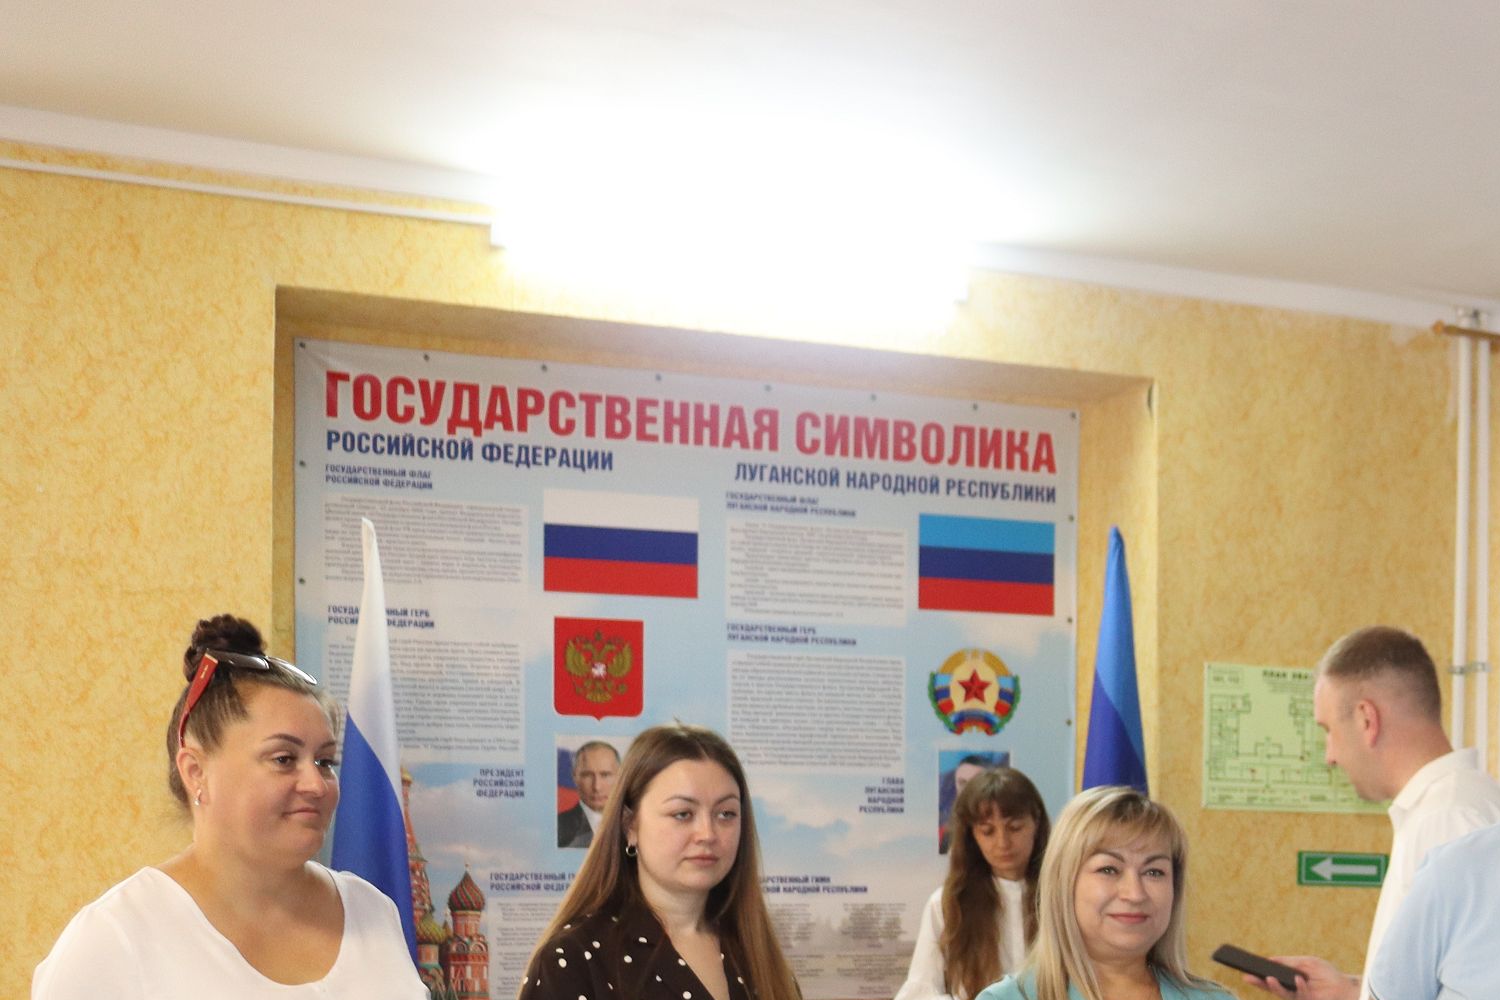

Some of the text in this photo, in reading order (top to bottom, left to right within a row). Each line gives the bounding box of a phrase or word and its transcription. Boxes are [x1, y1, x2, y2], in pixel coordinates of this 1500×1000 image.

[325, 370, 1057, 474] ГОСУДАРСТВЕННАЯ СИМВОЛИКА
[326, 430, 614, 473] РОССИЙСКОЙ ФЕДЕРАЦИИ
[325, 463, 432, 479] ГОСУДАРСТВЕННЫЙ ФЛАГ
[325, 474, 433, 490] РОССИЙСКОЙ ФЕДЕРАЦИИ
[734, 462, 1057, 504] ЛУГАНСКОЙ НАРОДНОЙ РЕСПУБЛИКИ
[411, 608, 430, 618] ГЕРБ
[480, 768, 524, 778] ПРЕЗИДЕНТ
[473, 778, 524, 787] РОССИЙСКОЙ
[476, 789, 524, 798] ФЕДЕРАЦИИ
[490, 871, 566, 881] ГОСУДАРСТВЕННЫЙ
